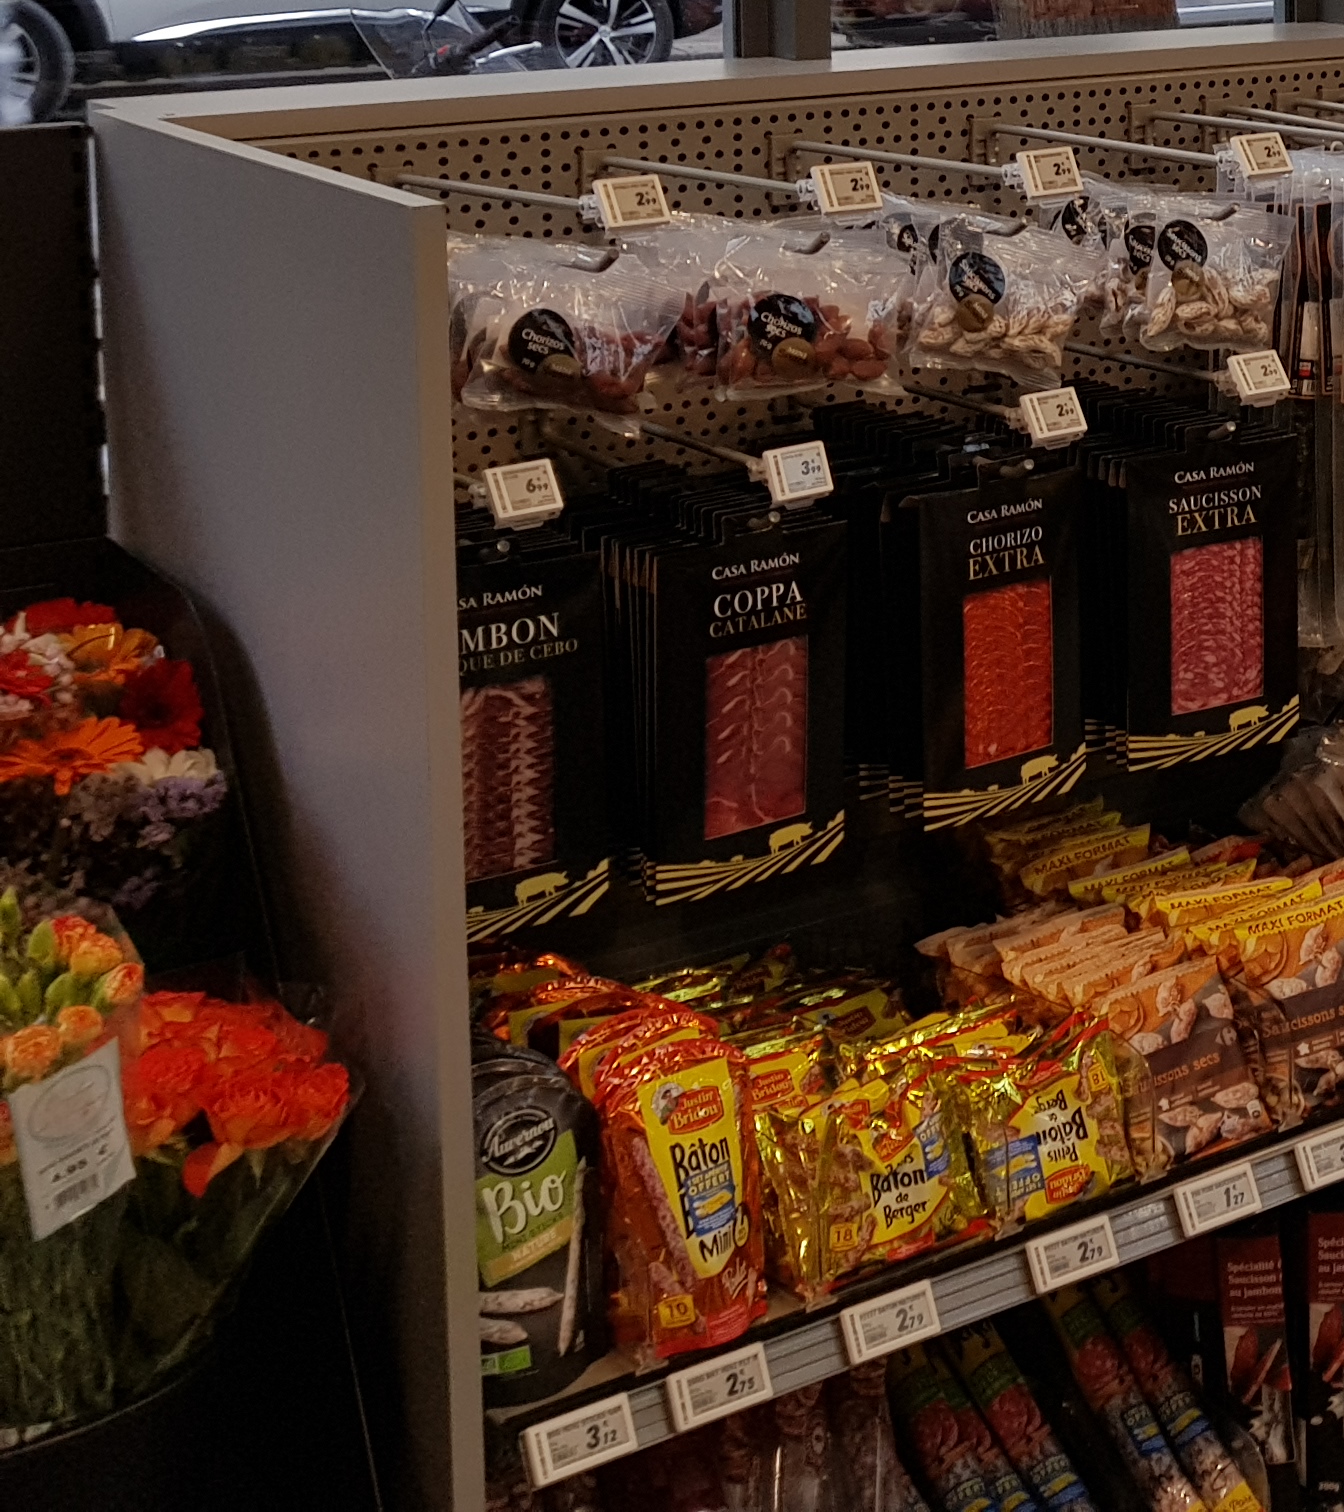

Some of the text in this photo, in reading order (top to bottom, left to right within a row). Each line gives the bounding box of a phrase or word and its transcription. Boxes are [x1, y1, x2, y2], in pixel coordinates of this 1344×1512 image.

[521, 328, 566, 352] Chorizos
[527, 341, 550, 356] secs
[1173, 461, 1255, 484] CASA RAMÓN
[967, 497, 1043, 524] CASA RAMÓN
[1168, 484, 1263, 515] SAUCISSON
[1175, 505, 1258, 537] EXTRA
[968, 525, 1043, 556] CHORIZO
[711, 552, 800, 581] CASA RAMÓN
[967, 546, 1045, 581] EXTRA
[482, 584, 543, 606] RAMÓN
[712, 580, 804, 619] COPPA
[460, 611, 560, 655] MBON
[708, 603, 808, 639] CATALANE
[499, 637, 579, 669] DE CEBO
[1032, 836, 1131, 876] MAXI FORMAT
[1247, 914, 1285, 936] MAXI
[1192, 1050, 1221, 1074] secs
[680, 1089, 715, 1110] Justin
[670, 1102, 719, 1129] Bridou
[669, 1136, 732, 1193] Bâton
[688, 1171, 732, 1197] OFFERT
[895, 1192, 910, 1204] de
[481, 1168, 568, 1245] Bio
[883, 1199, 928, 1229] Berger
[698, 1226, 733, 1264] Mini
[833, 1226, 853, 1243] 18
[668, 1302, 689, 1320] 10
